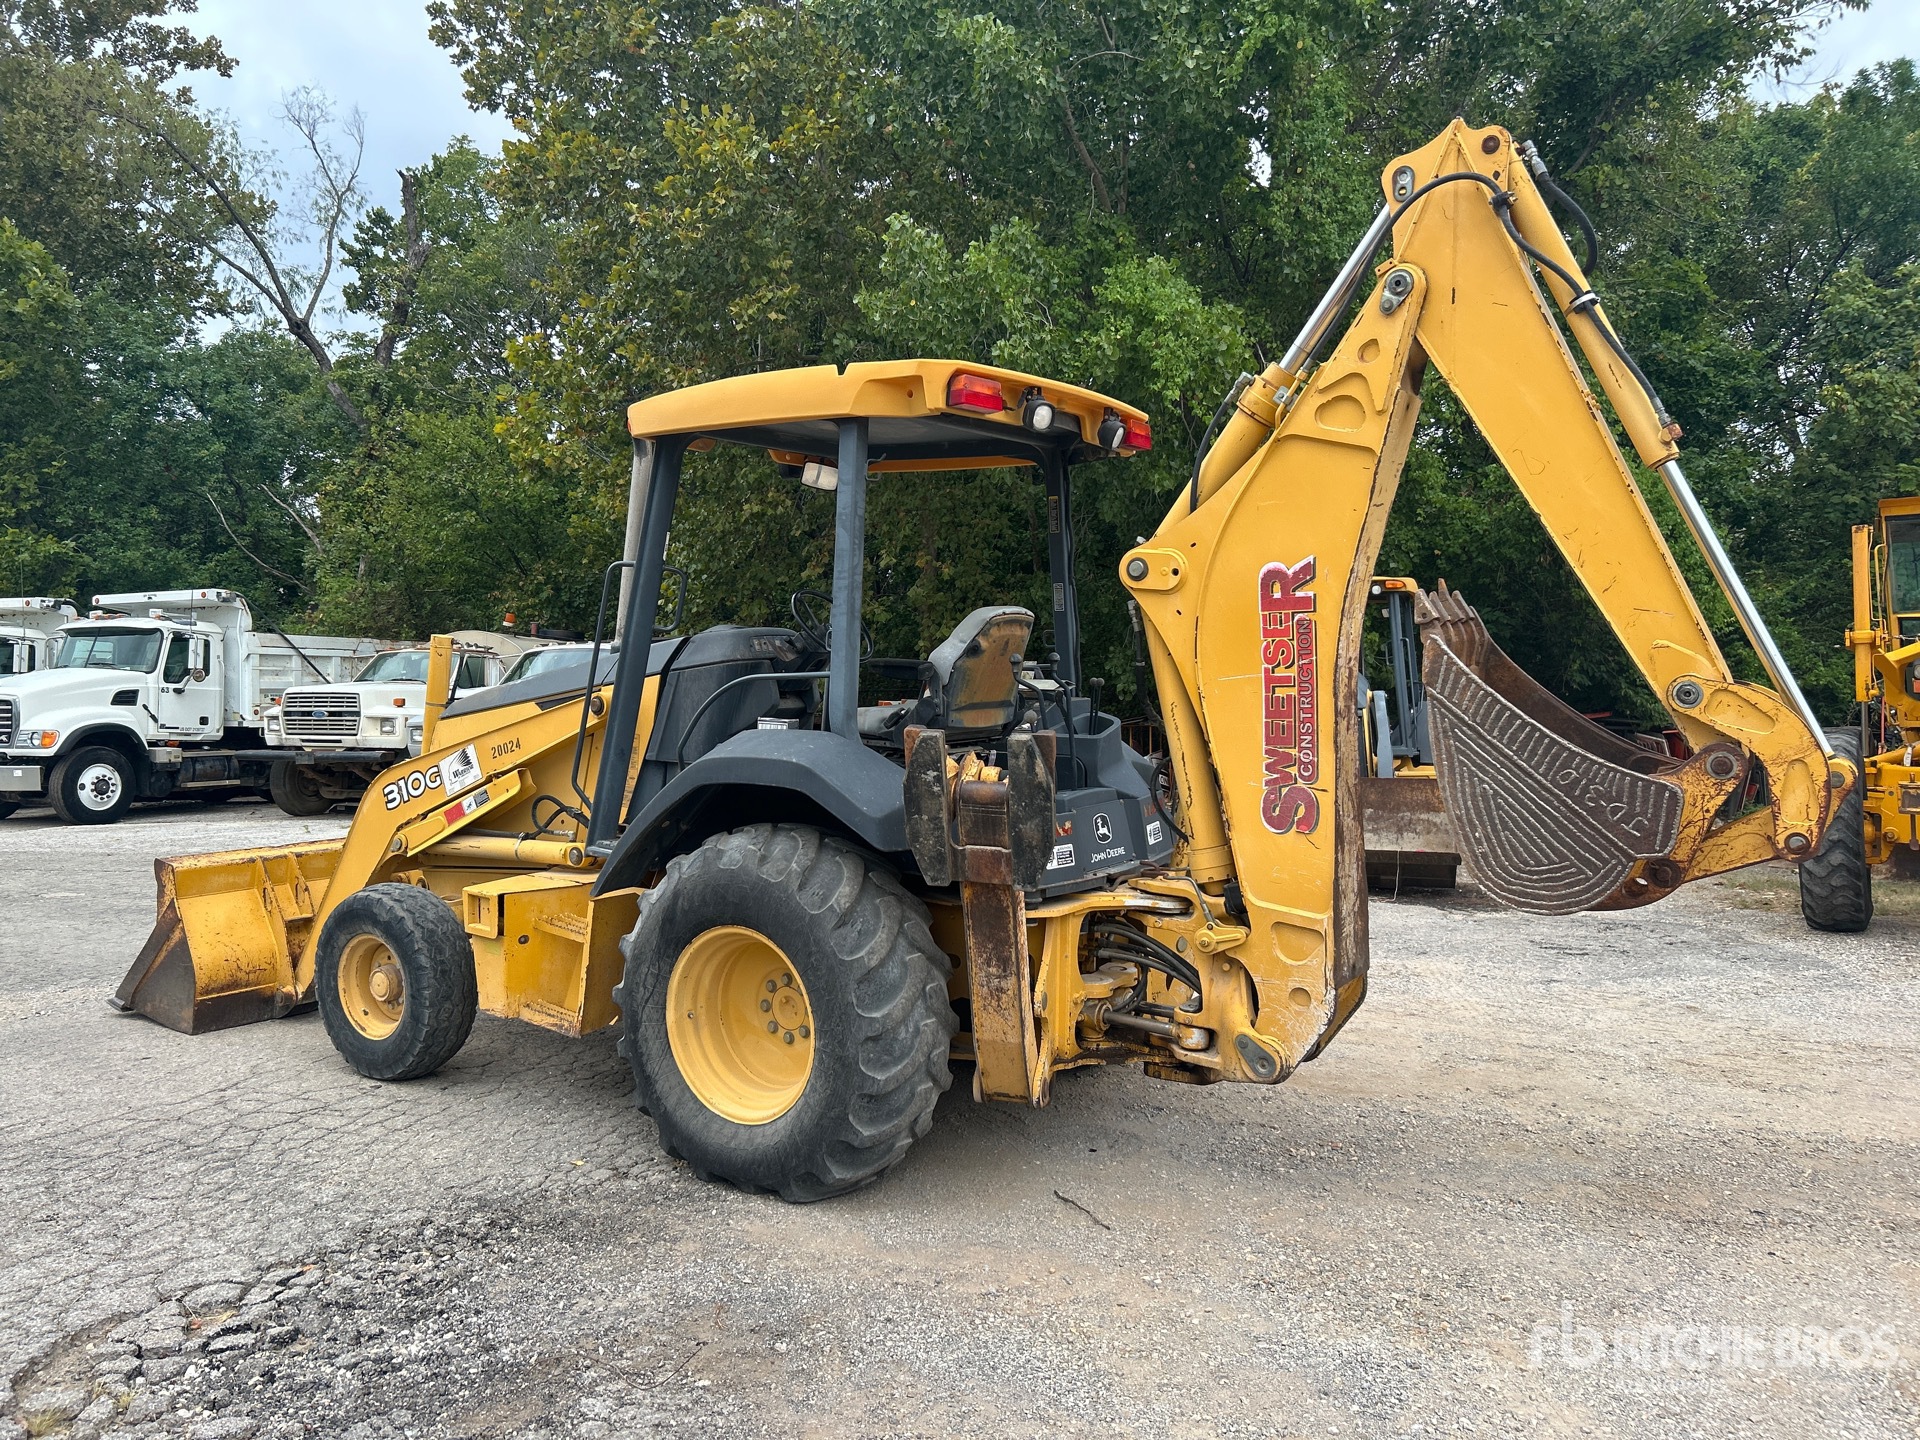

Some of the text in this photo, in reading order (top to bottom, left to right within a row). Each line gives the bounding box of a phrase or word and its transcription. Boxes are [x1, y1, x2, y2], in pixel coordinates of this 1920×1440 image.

[1259, 554, 1319, 834] SWEETSER
[1298, 618, 1314, 776] CONSTRUCTION
[490, 737, 522, 760] 20024
[382, 765, 443, 811] 310G
[1091, 846, 1126, 864] JOHN DEERE
